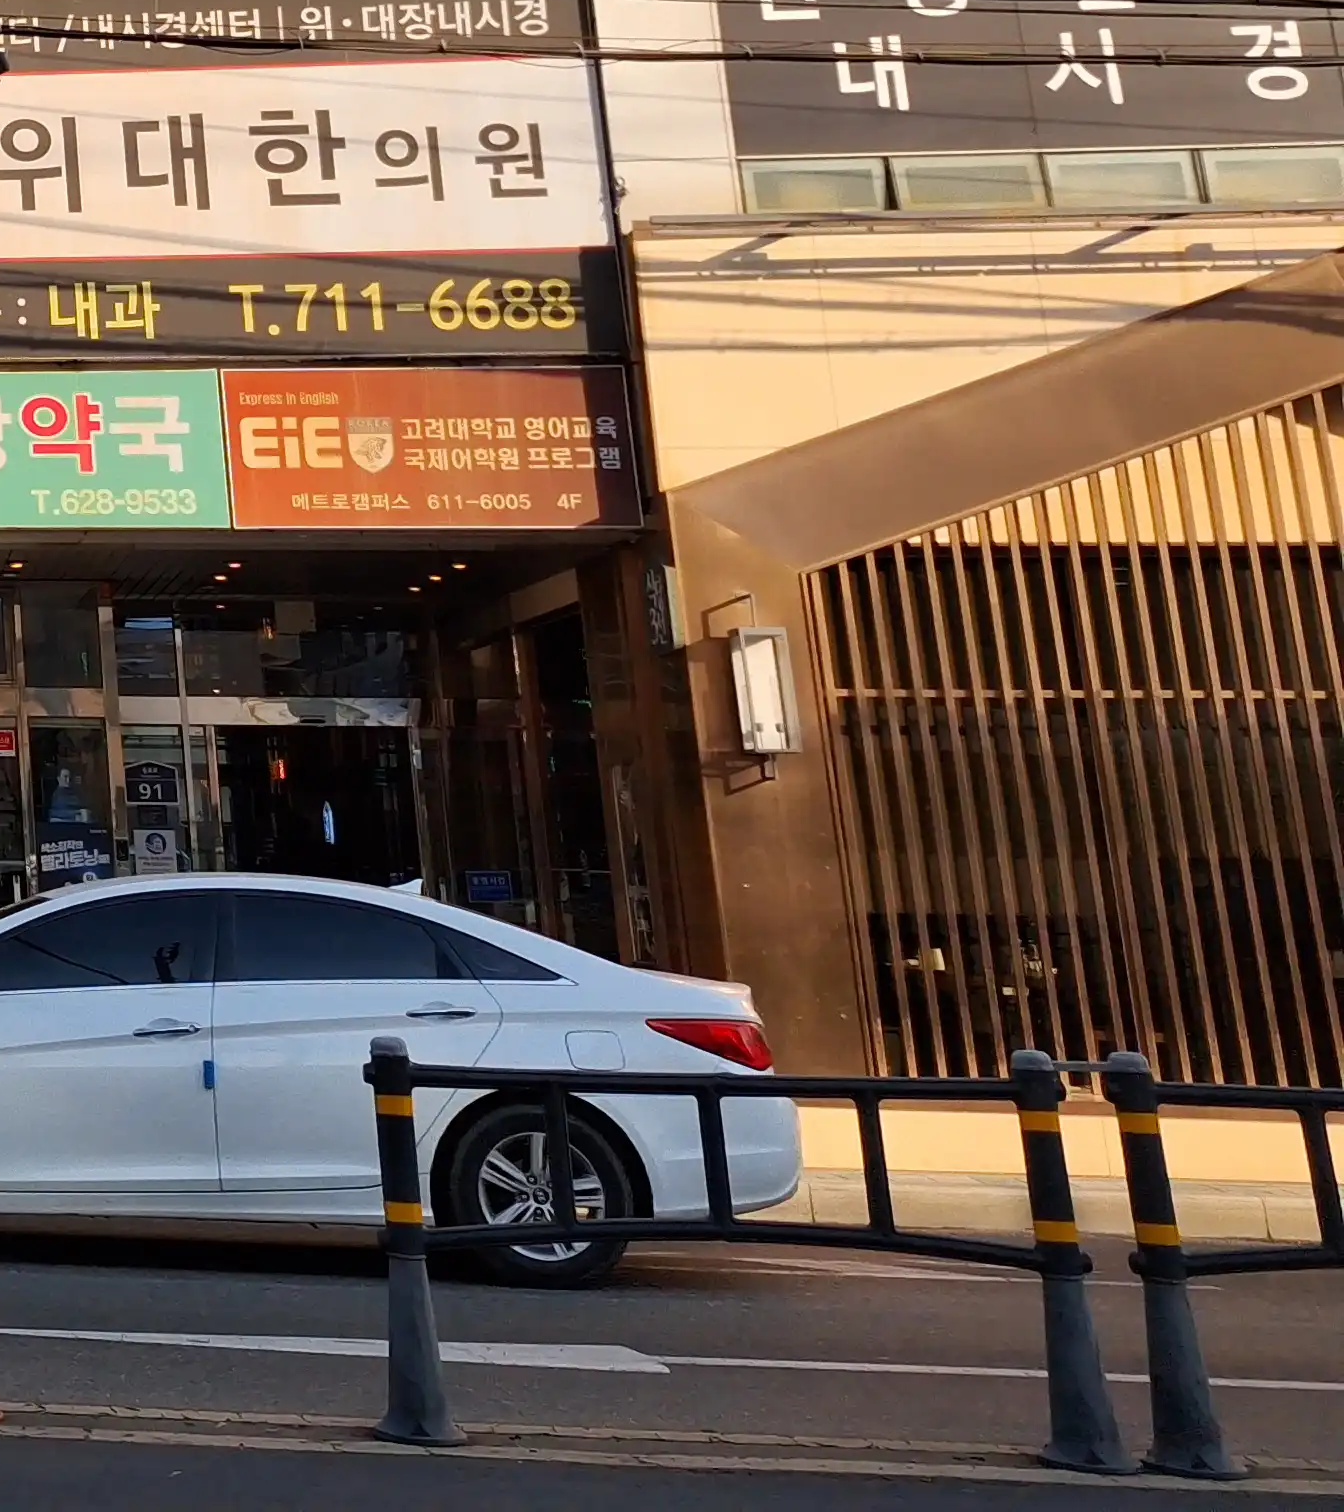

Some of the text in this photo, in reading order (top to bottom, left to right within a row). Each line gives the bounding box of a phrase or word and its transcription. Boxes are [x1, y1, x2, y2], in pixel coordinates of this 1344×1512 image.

[832, 19, 1310, 112] 내시경
[47, 281, 161, 340] 내과
[229, 278, 576, 339] T.711-6688
[239, 391, 283, 406] Express
[299, 391, 340, 406] English
[400, 415, 617, 441] 고려대학교 영어교육
[239, 416, 344, 469] EiE
[403, 446, 621, 471] 국제어학원 프로그램
[291, 492, 583, 513] 메트로캠퍼스 611-6005 4F
[138, 782, 163, 801] 91
